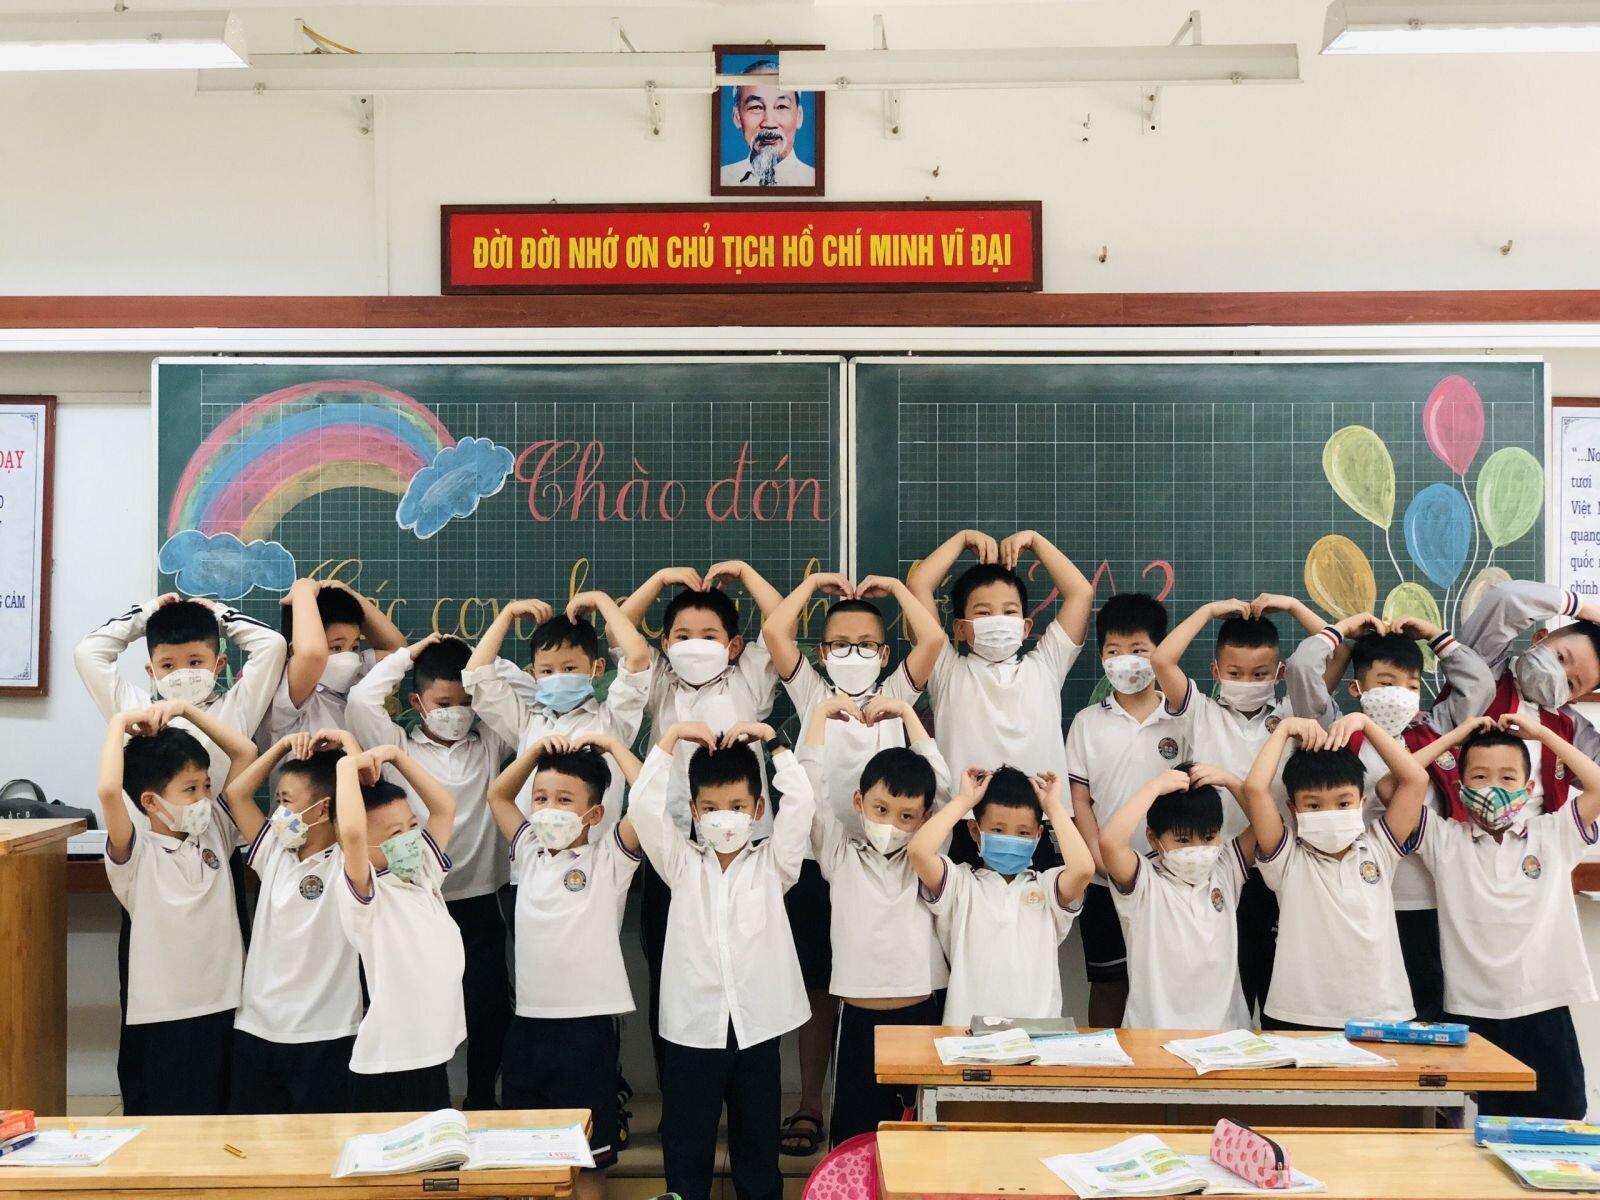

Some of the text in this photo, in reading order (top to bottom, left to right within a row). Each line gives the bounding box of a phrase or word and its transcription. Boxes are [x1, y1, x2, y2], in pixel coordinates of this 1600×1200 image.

[473, 223, 1011, 274] ĐỜI ĐỜI NHỚ ƠN CHỦ TỊCH HỒ CHÍ MINH VĨ ĐẠI
[514, 439, 838, 522] Chào đón
[1570, 500, 1592, 518] Việt
[1570, 549, 1595, 572] quốc
[4, 589, 26, 609] CẢM
